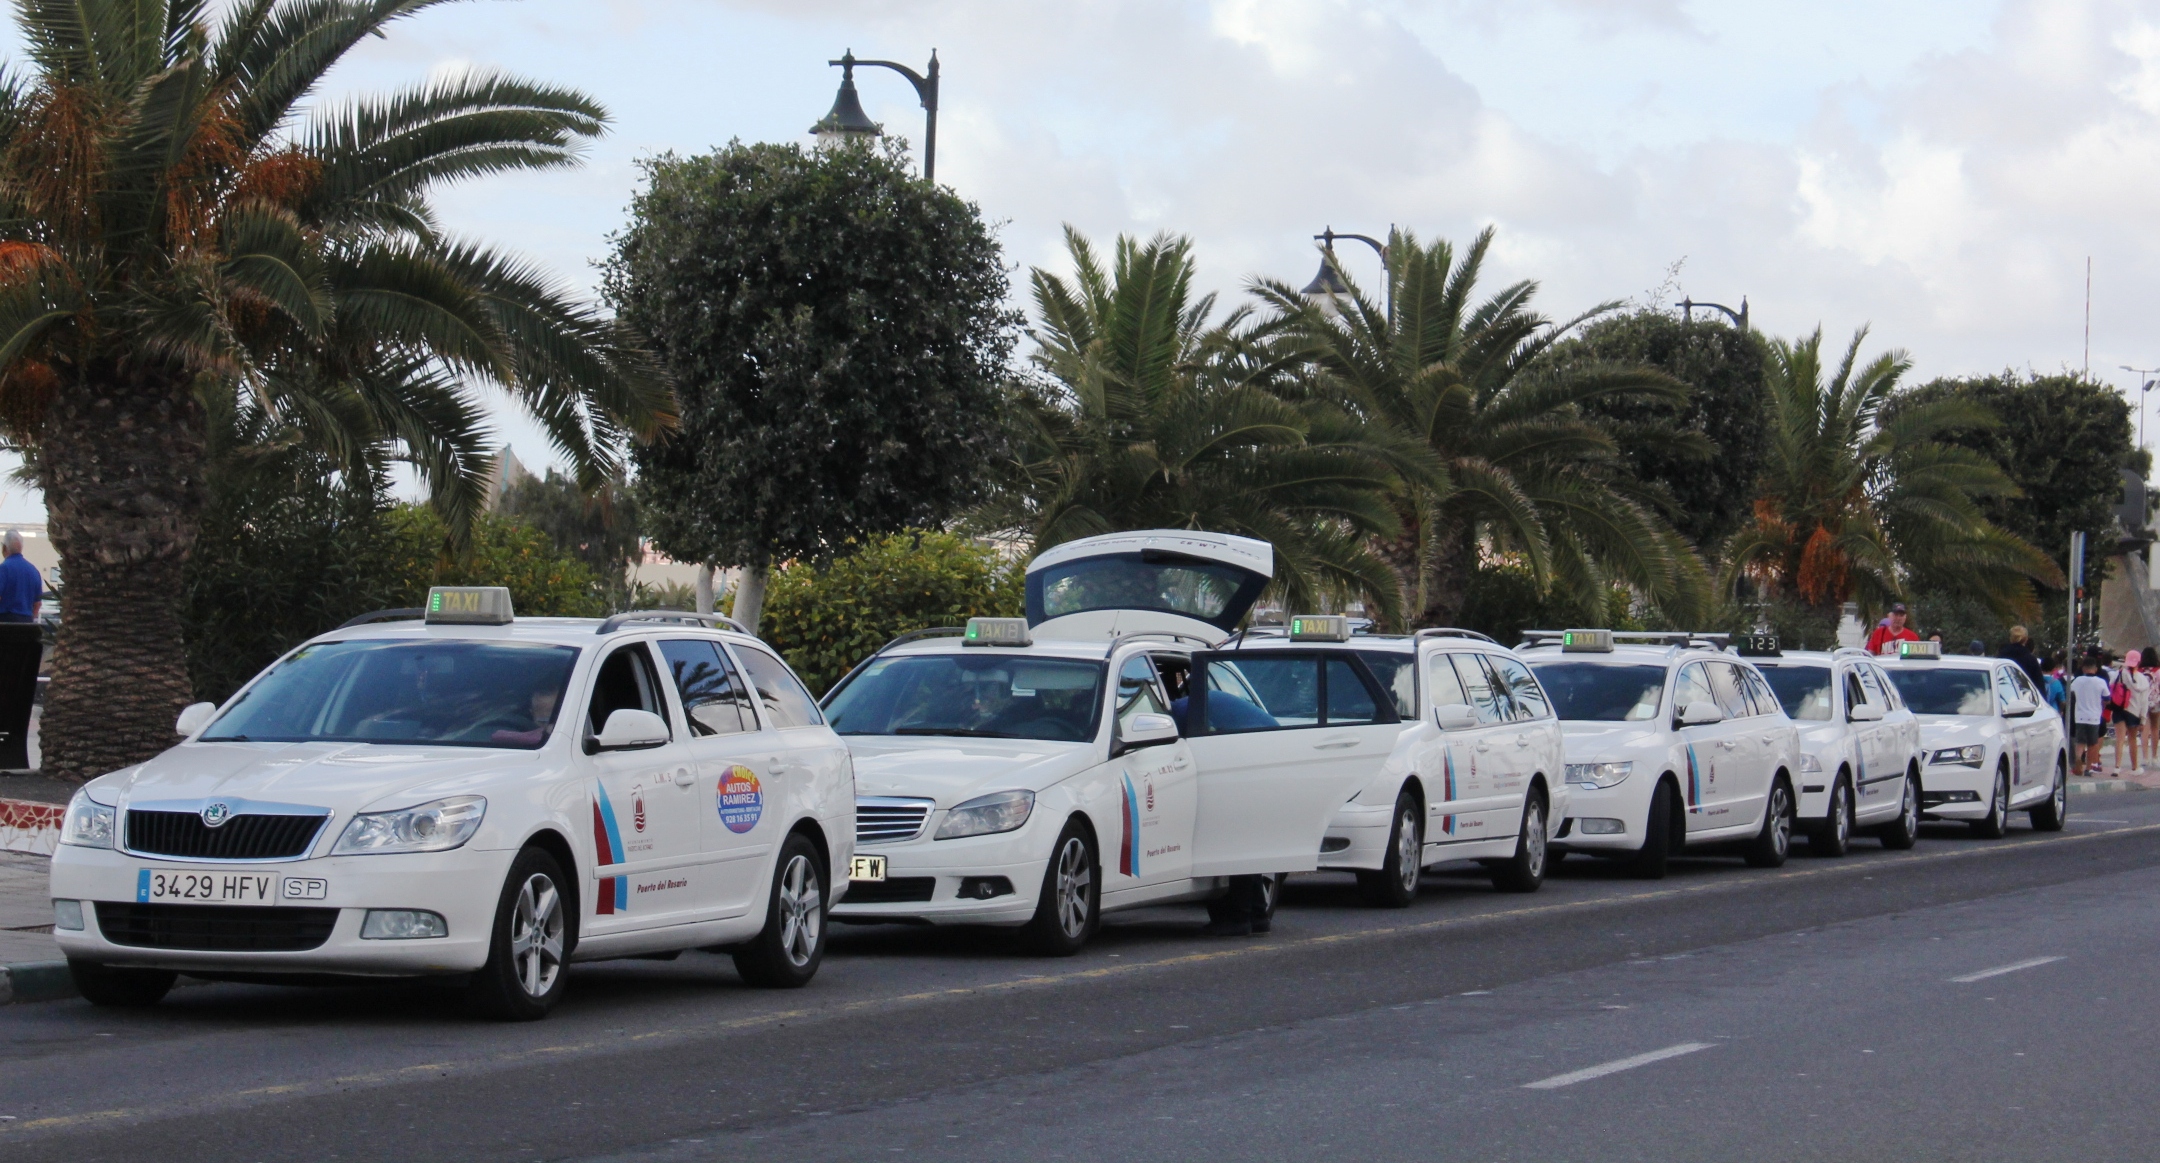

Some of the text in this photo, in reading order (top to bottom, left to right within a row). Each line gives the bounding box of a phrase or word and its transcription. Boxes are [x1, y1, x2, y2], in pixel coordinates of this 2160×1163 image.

[443, 592, 479, 612] TAXI
[980, 623, 1005, 638] TAXI
[1303, 620, 1328, 633] TAXI
[1573, 633, 1595, 645] TAXI
[1749, 637, 1776, 650] 123
[1910, 644, 1927, 654] TAXI
[726, 782, 752, 793] AUTOS
[723, 793, 756, 805] RAMIREZ
[725, 813, 757, 824] 928 16 35 91
[1147, 849, 1159, 858] Puerto
[153, 874, 213, 898] 3429
[222, 876, 269, 900] HFV
[288, 881, 322, 896] SP
[637, 877, 687, 893] Puerto del Rosario
